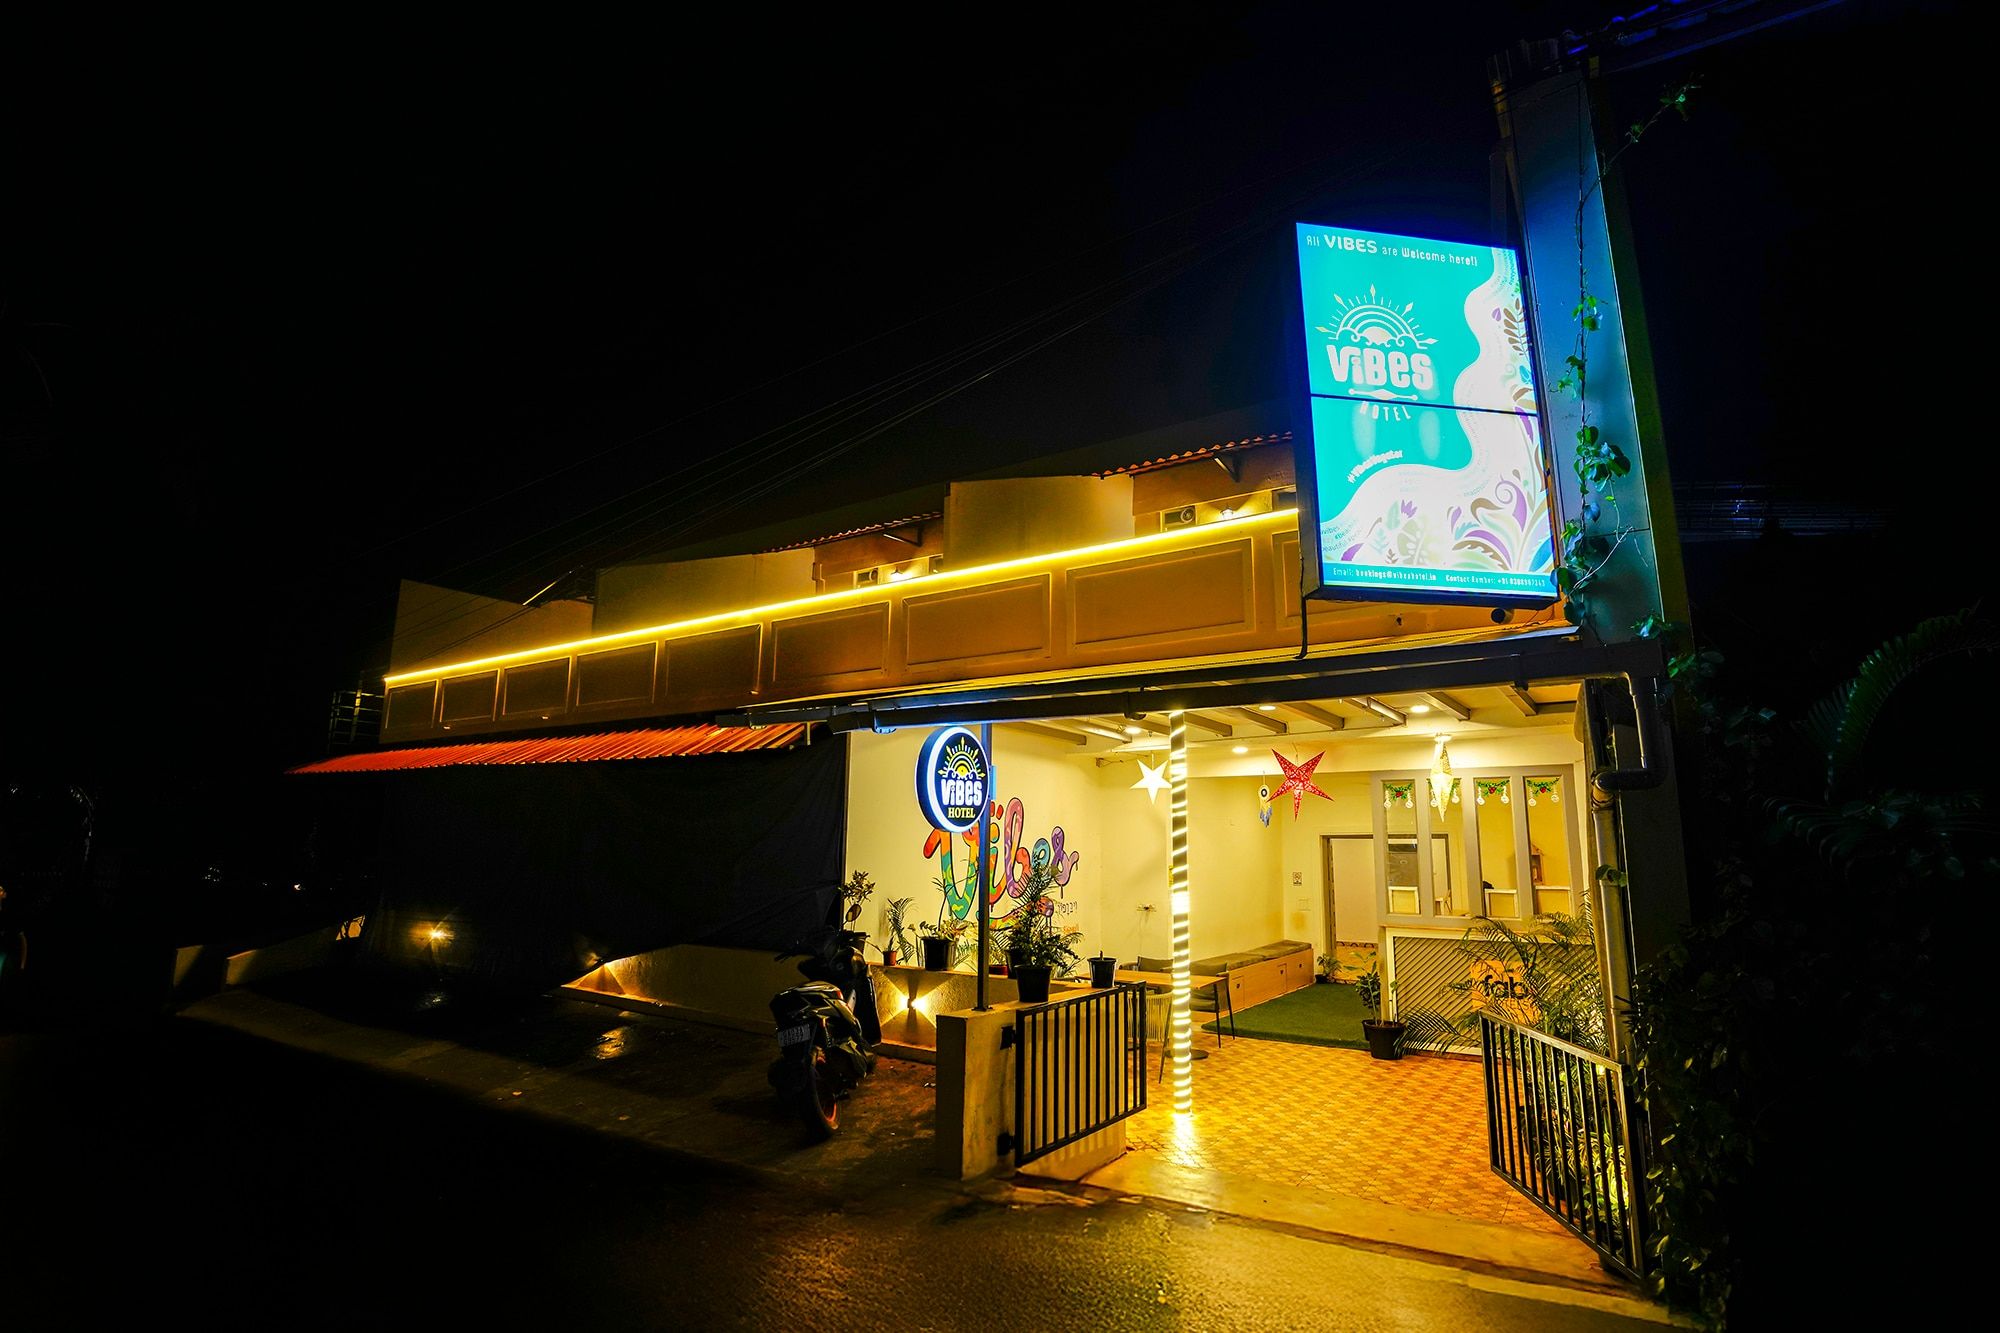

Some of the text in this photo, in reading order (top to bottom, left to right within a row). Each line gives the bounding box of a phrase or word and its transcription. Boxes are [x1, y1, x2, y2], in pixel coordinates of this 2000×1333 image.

[1306, 234, 1320, 247] All
[1323, 234, 1378, 254] VIBES
[1381, 246, 1398, 257] are
[1401, 247, 1446, 263] Welcome
[1359, 400, 1412, 422] HOTEL
[948, 807, 976, 819] HOTEL
